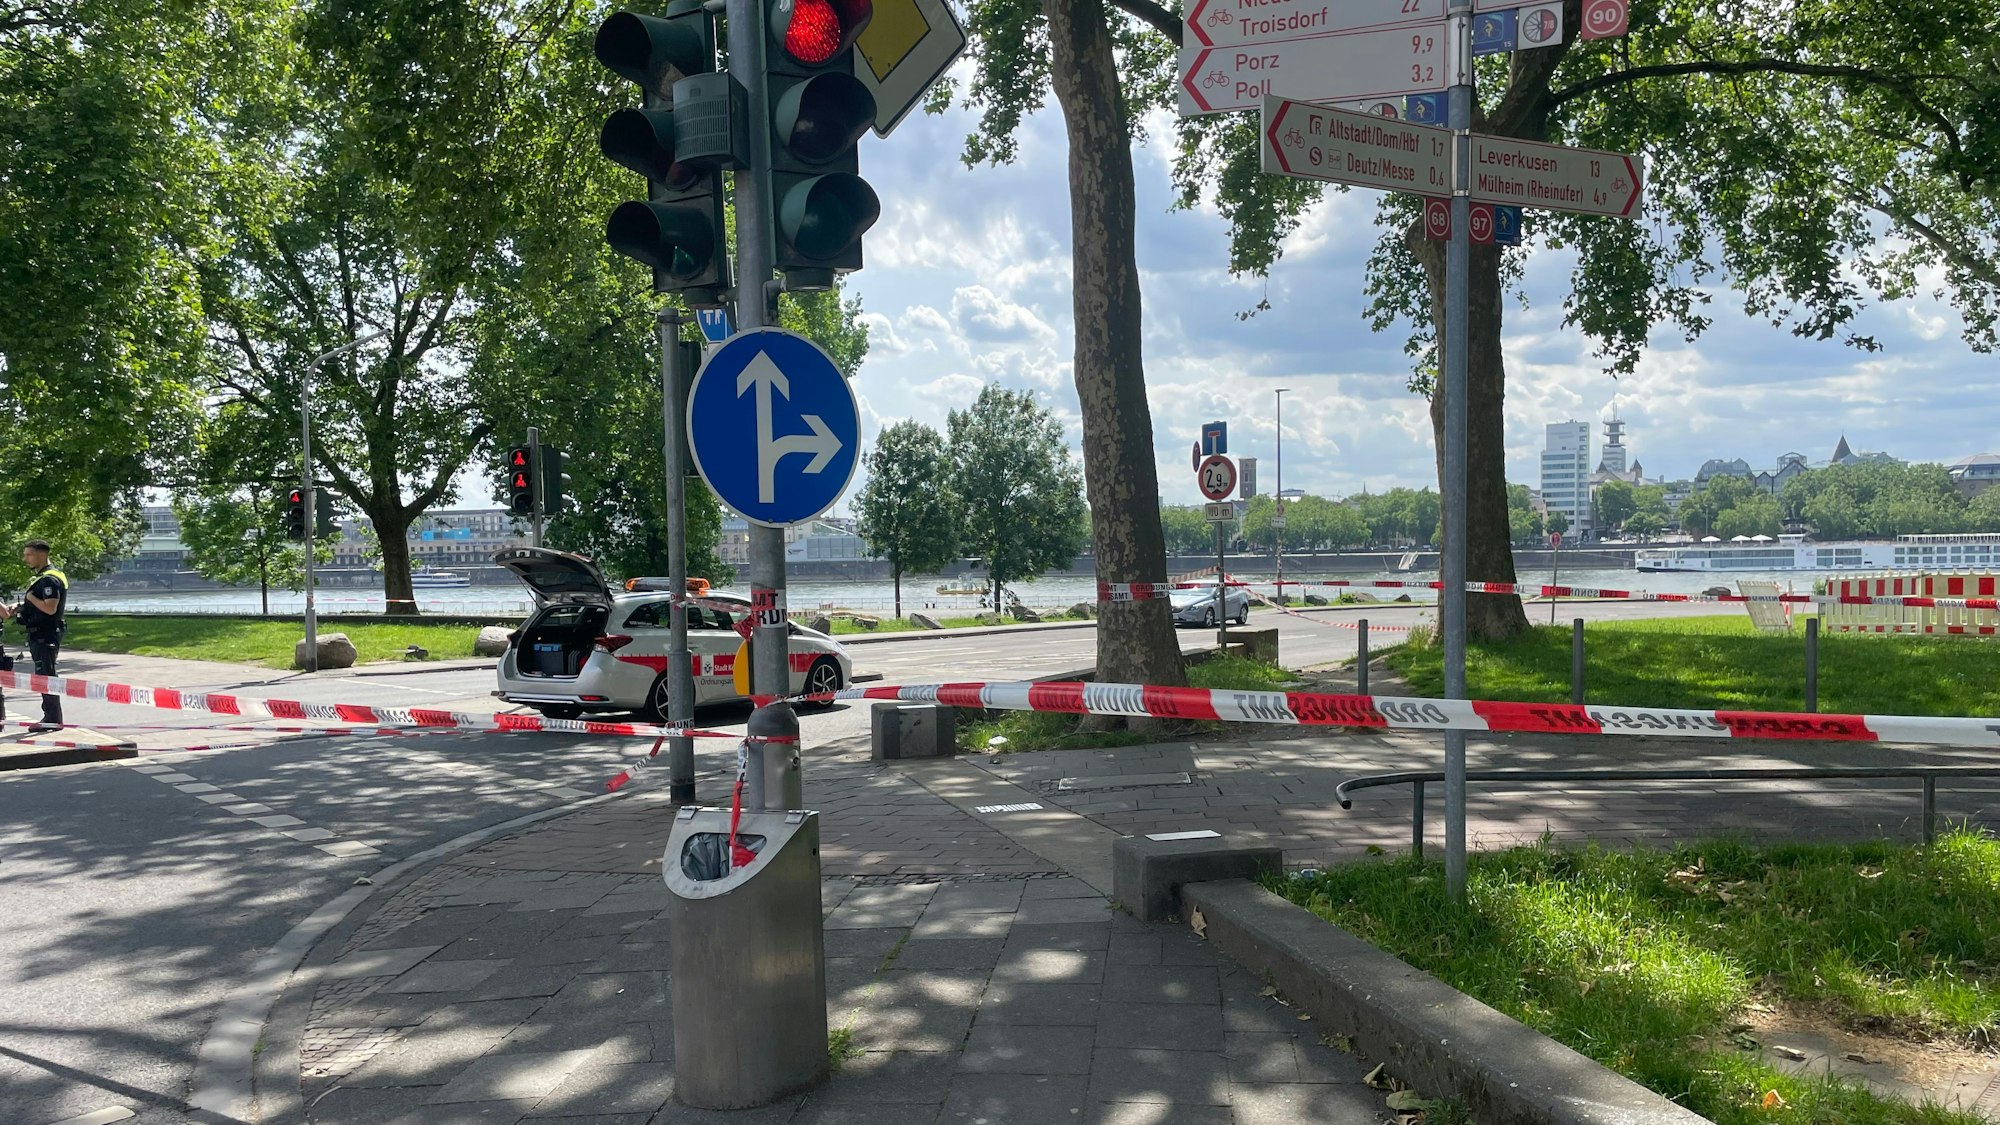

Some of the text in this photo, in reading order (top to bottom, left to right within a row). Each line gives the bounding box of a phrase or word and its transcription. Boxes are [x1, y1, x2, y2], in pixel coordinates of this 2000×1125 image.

[1239, 7, 1328, 36] Troisdorf
[1401, 0, 1420, 13] 22
[1592, 8, 1617, 24] 90
[1236, 35, 1434, 72] Porz 9,9
[1236, 64, 1434, 99] Poll 3,2
[1328, 118, 1420, 153] Altstadt/Dom/Hbf
[1431, 137, 1444, 157] 1,7
[1347, 152, 1415, 181] Deutz/Messe
[1429, 166, 1444, 186] 0,6
[1479, 145, 1600, 178] Leverkusen 13
[1478, 173, 1607, 206] Mülheim (Rheinufer) 4,9
[1431, 212, 1446, 226] 68
[1472, 217, 1489, 231] 97
